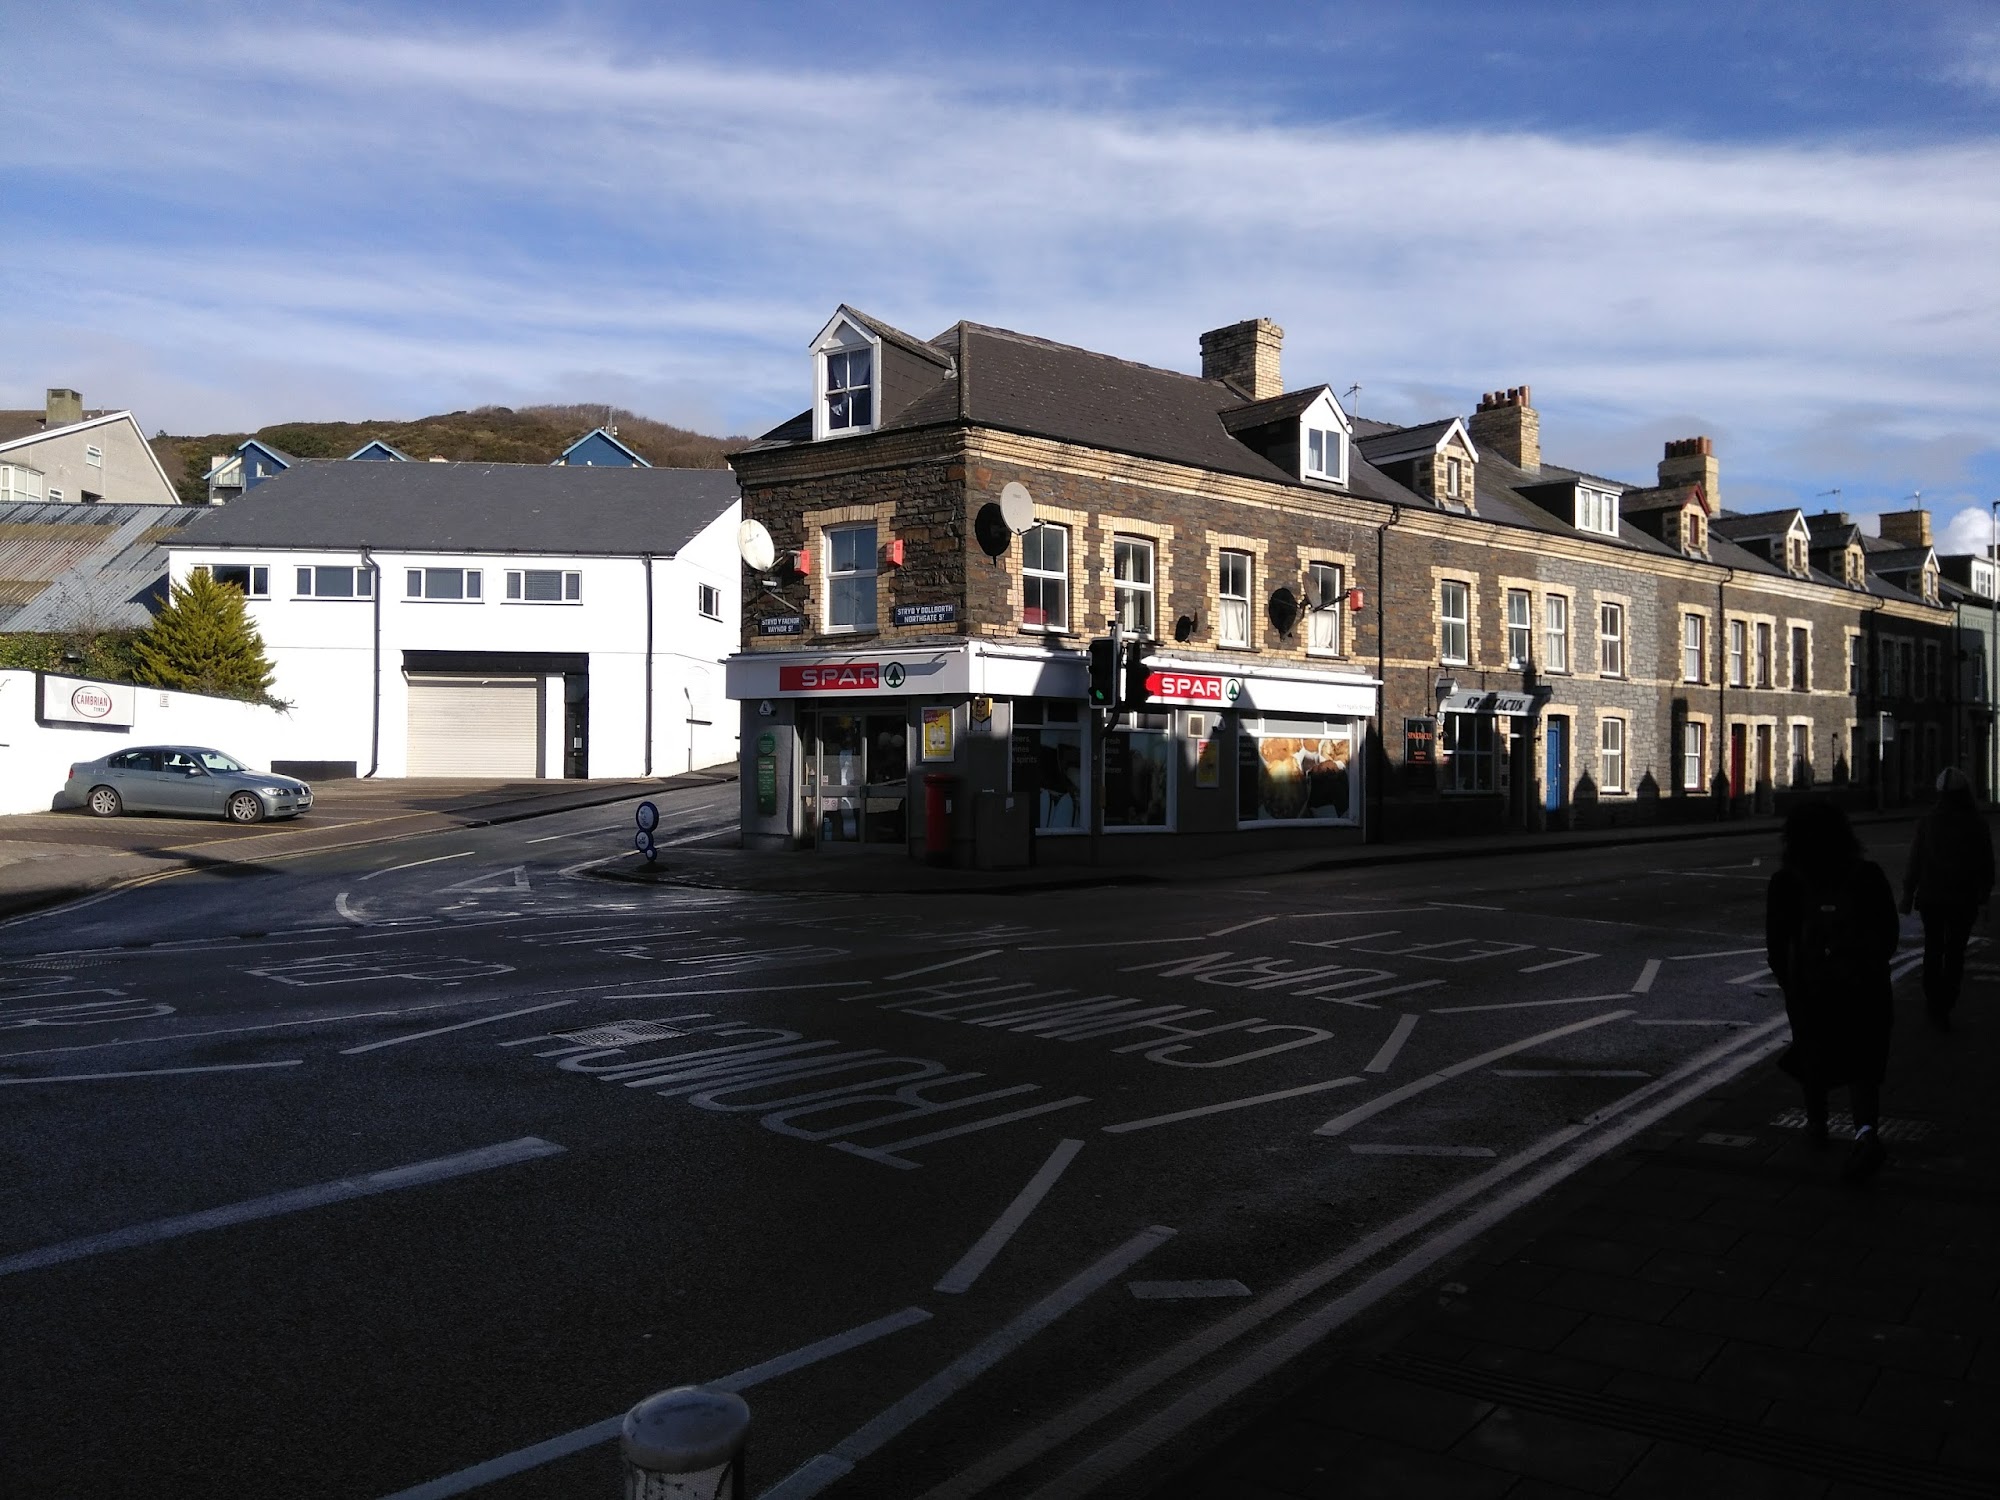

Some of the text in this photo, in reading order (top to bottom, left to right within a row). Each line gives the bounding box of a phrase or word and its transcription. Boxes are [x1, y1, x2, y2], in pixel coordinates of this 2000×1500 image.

[897, 607, 916, 615] STRYD
[903, 614, 938, 623] NORTHGATE
[802, 667, 878, 687] SPAR
[1161, 677, 1221, 697] SPAR
[76, 694, 108, 708] CAMBRIAN
[1289, 930, 1602, 974] LEFT
[1115, 952, 1446, 1009] TURN
[838, 977, 1335, 1068] CHWITH
[500, 1013, 1094, 1170] TROWCH
